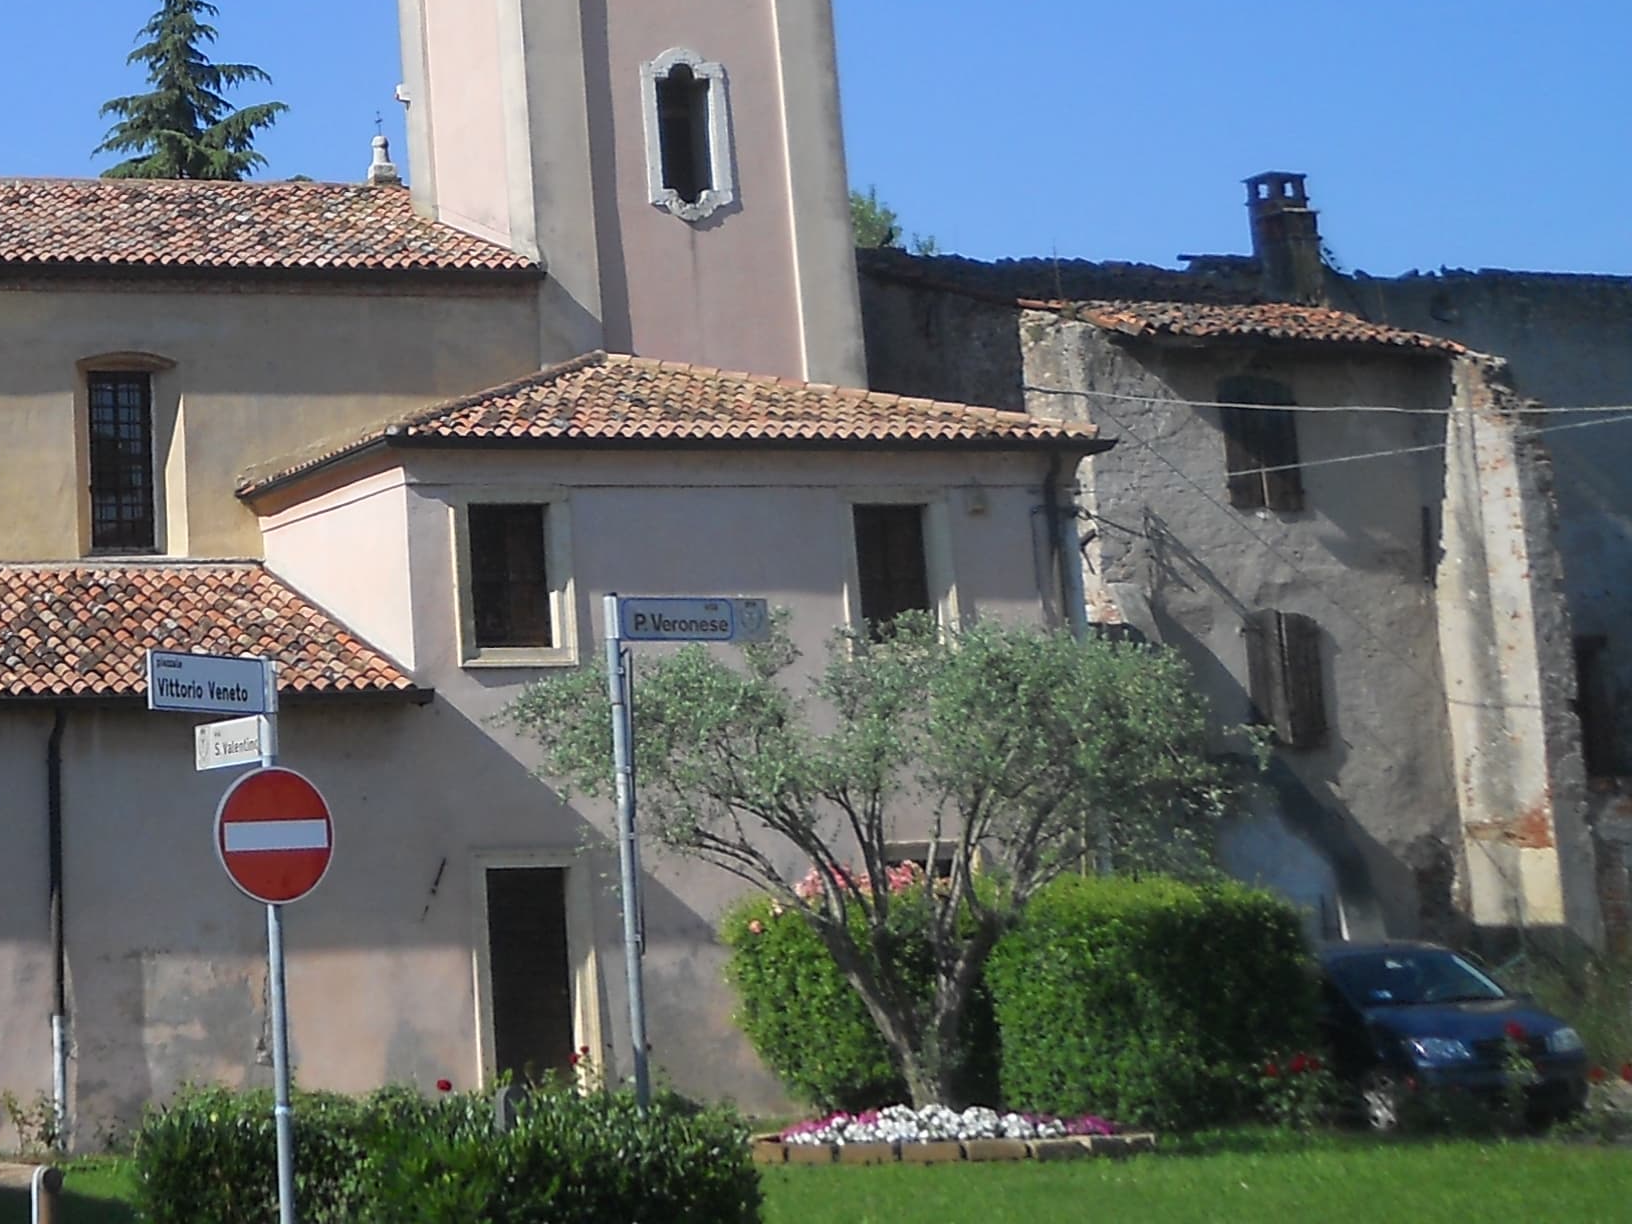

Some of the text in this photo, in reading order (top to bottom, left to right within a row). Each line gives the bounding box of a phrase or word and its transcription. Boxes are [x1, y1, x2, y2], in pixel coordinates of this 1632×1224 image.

[650, 613, 729, 633] Veronese
[156, 677, 249, 702] Vittorio Veneto
